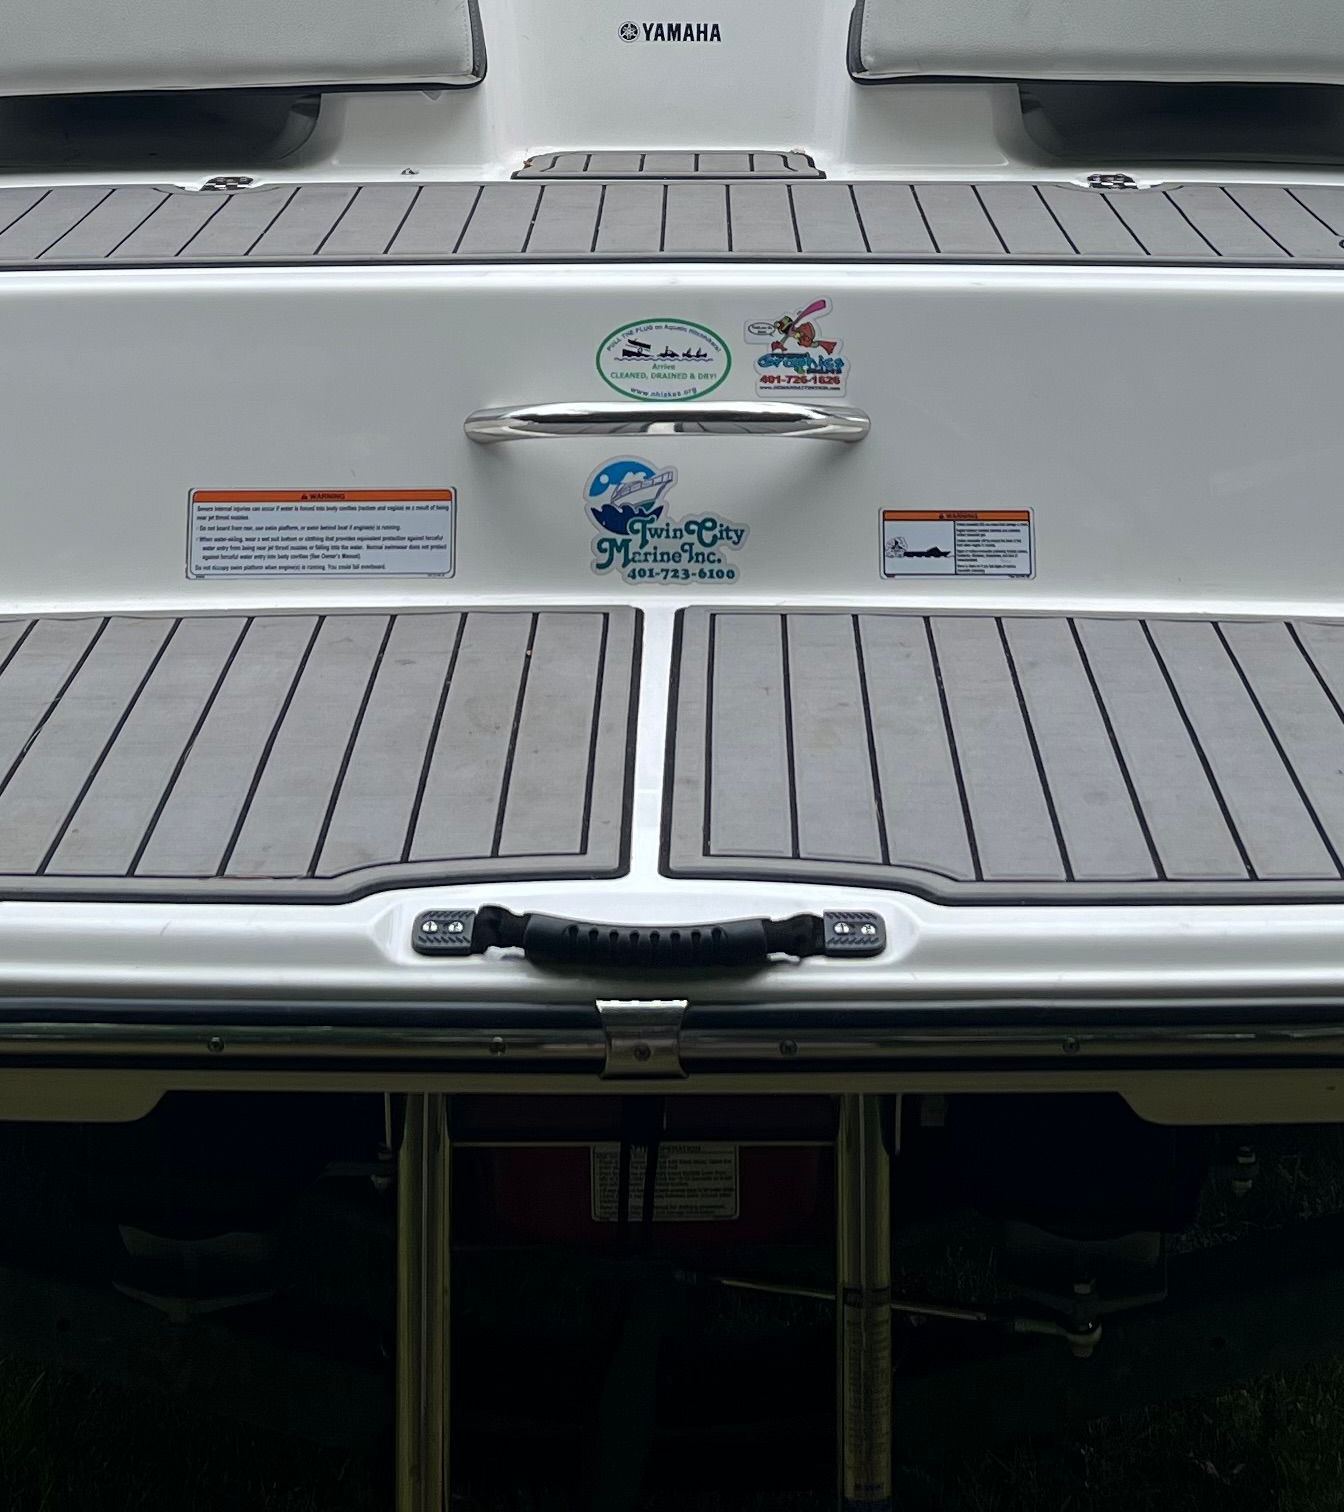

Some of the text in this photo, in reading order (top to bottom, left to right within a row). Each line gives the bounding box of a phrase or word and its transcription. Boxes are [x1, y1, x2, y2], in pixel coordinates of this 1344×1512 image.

[642, 23, 721, 42] YAMAHA
[610, 372, 648, 380] CLEANED,
[651, 372, 687, 380] DRAINED
[690, 372, 695, 380] &
[629, 517, 744, 549] Twin City
[596, 538, 721, 570] Marine Inc.
[627, 568, 735, 580] 401-723-6100
